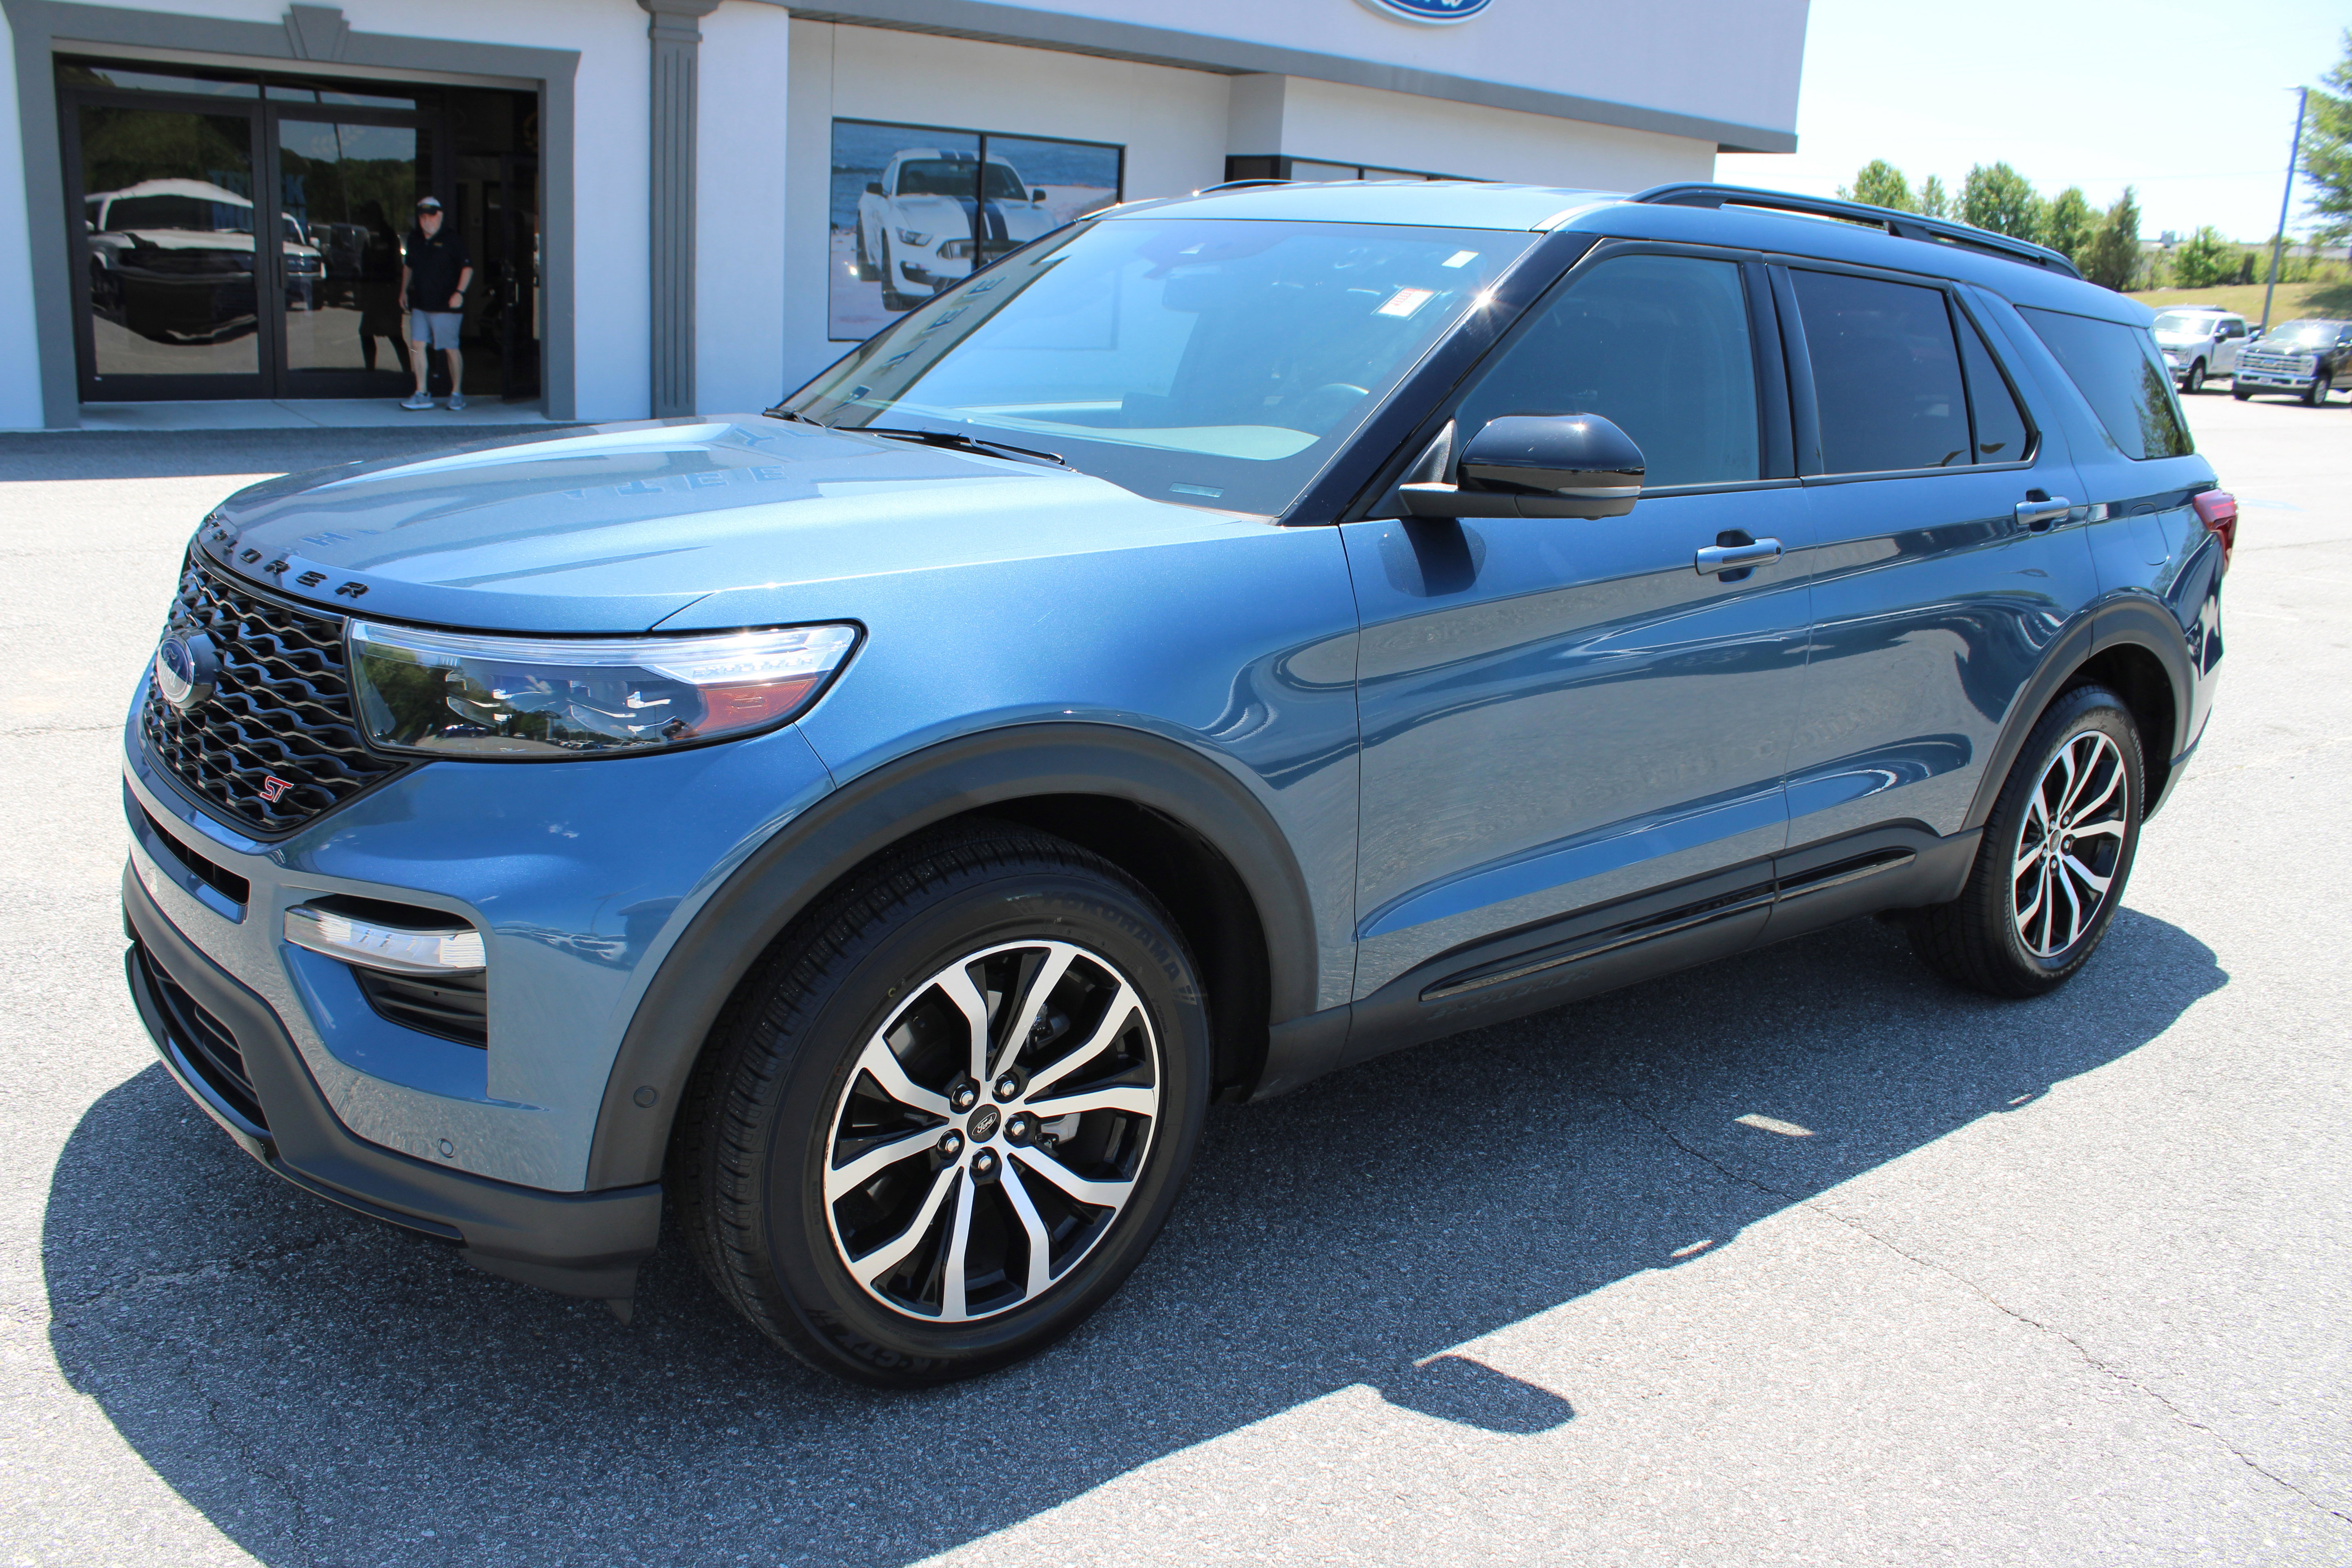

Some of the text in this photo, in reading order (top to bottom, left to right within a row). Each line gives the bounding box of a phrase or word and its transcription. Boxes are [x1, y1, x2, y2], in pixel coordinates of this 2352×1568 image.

[207, 169, 307, 204] TRK
[204, 512, 370, 598] EXPLORER
[159, 646, 180, 688] Ford
[2130, 728, 2145, 804] DESTINATION
[260, 775, 294, 803] ST
[1038, 890, 1183, 984] YOKOHAMA
[977, 1116, 993, 1134] Ford
